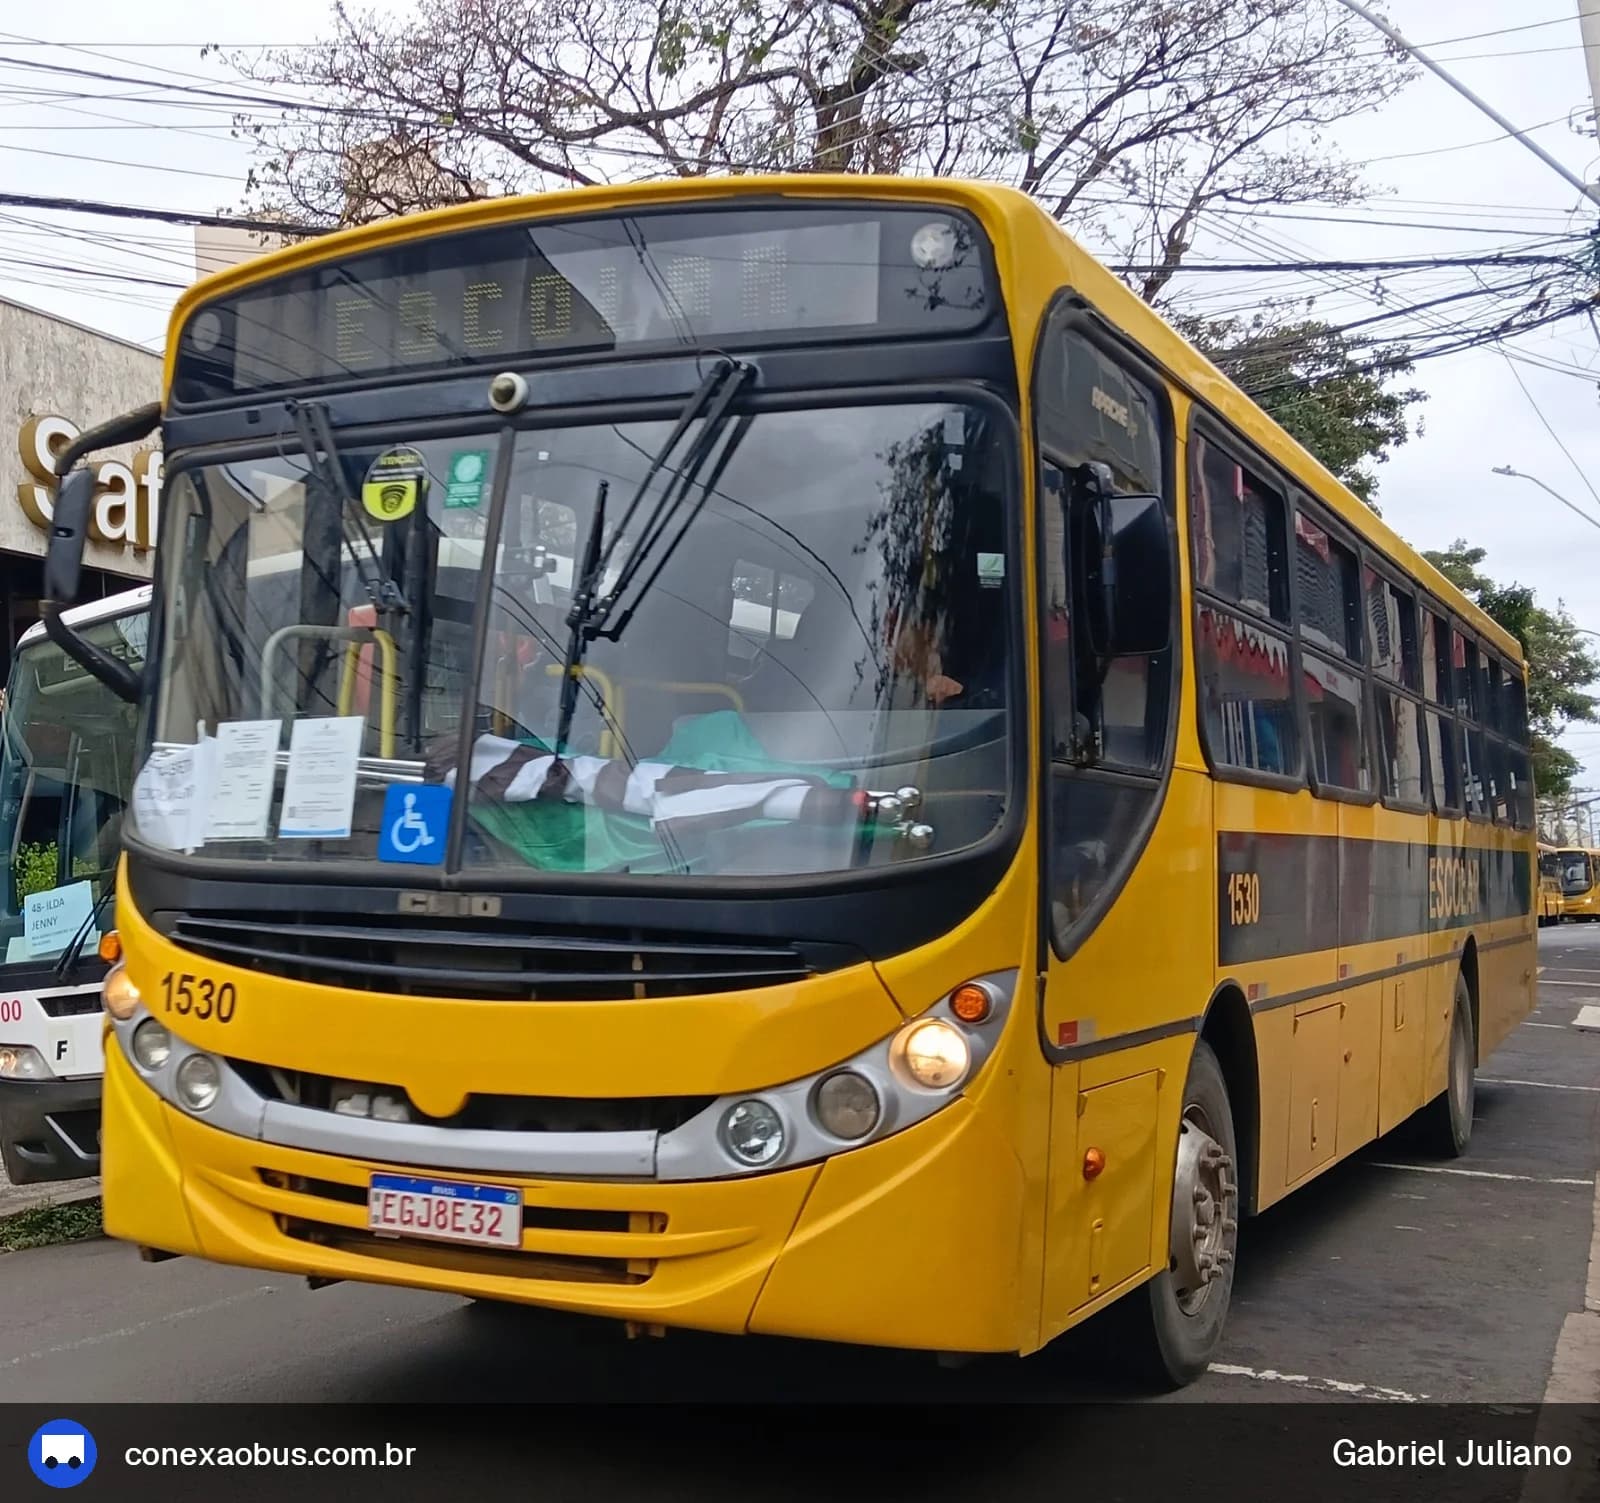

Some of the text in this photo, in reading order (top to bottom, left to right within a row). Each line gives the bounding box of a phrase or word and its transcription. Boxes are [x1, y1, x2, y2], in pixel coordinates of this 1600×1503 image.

[334, 245, 788, 363] ESCOLAR
[1228, 872, 1260, 926] 1530
[1429, 857, 1480, 919] ESCOLAR
[31, 916, 58, 931] JENNY
[160, 971, 236, 1024] 1530
[56, 1039, 69, 1061] F
[382, 1192, 503, 1238] EGJ8E32
